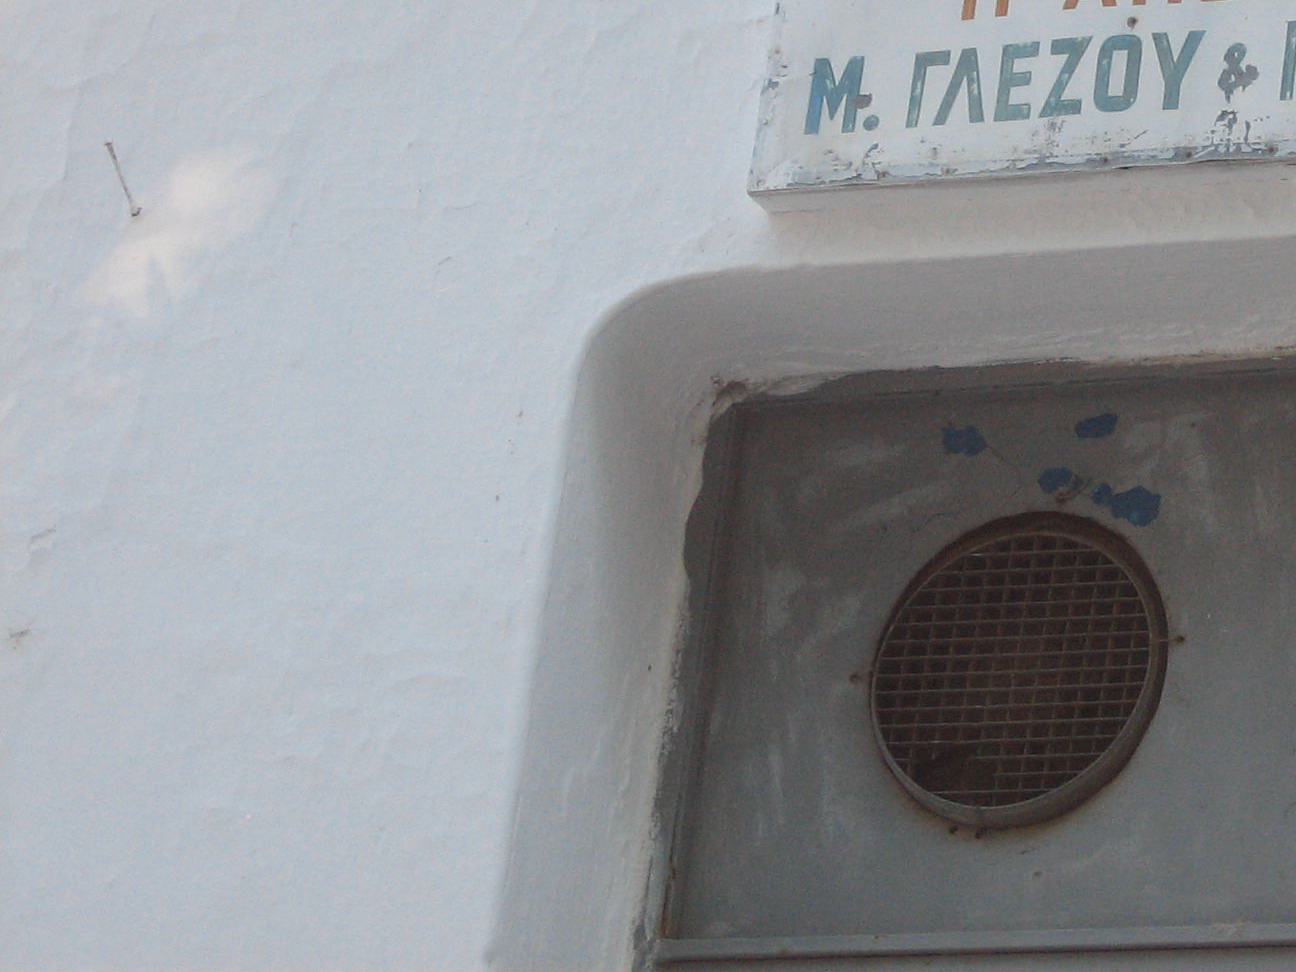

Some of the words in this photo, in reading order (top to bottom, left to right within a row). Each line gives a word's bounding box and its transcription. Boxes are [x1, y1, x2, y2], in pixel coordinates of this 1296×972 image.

[803, 54, 881, 135] Μ.
[904, 29, 1207, 129] ΓΛΕΖΟΥ
[1216, 42, 1260, 102] &
